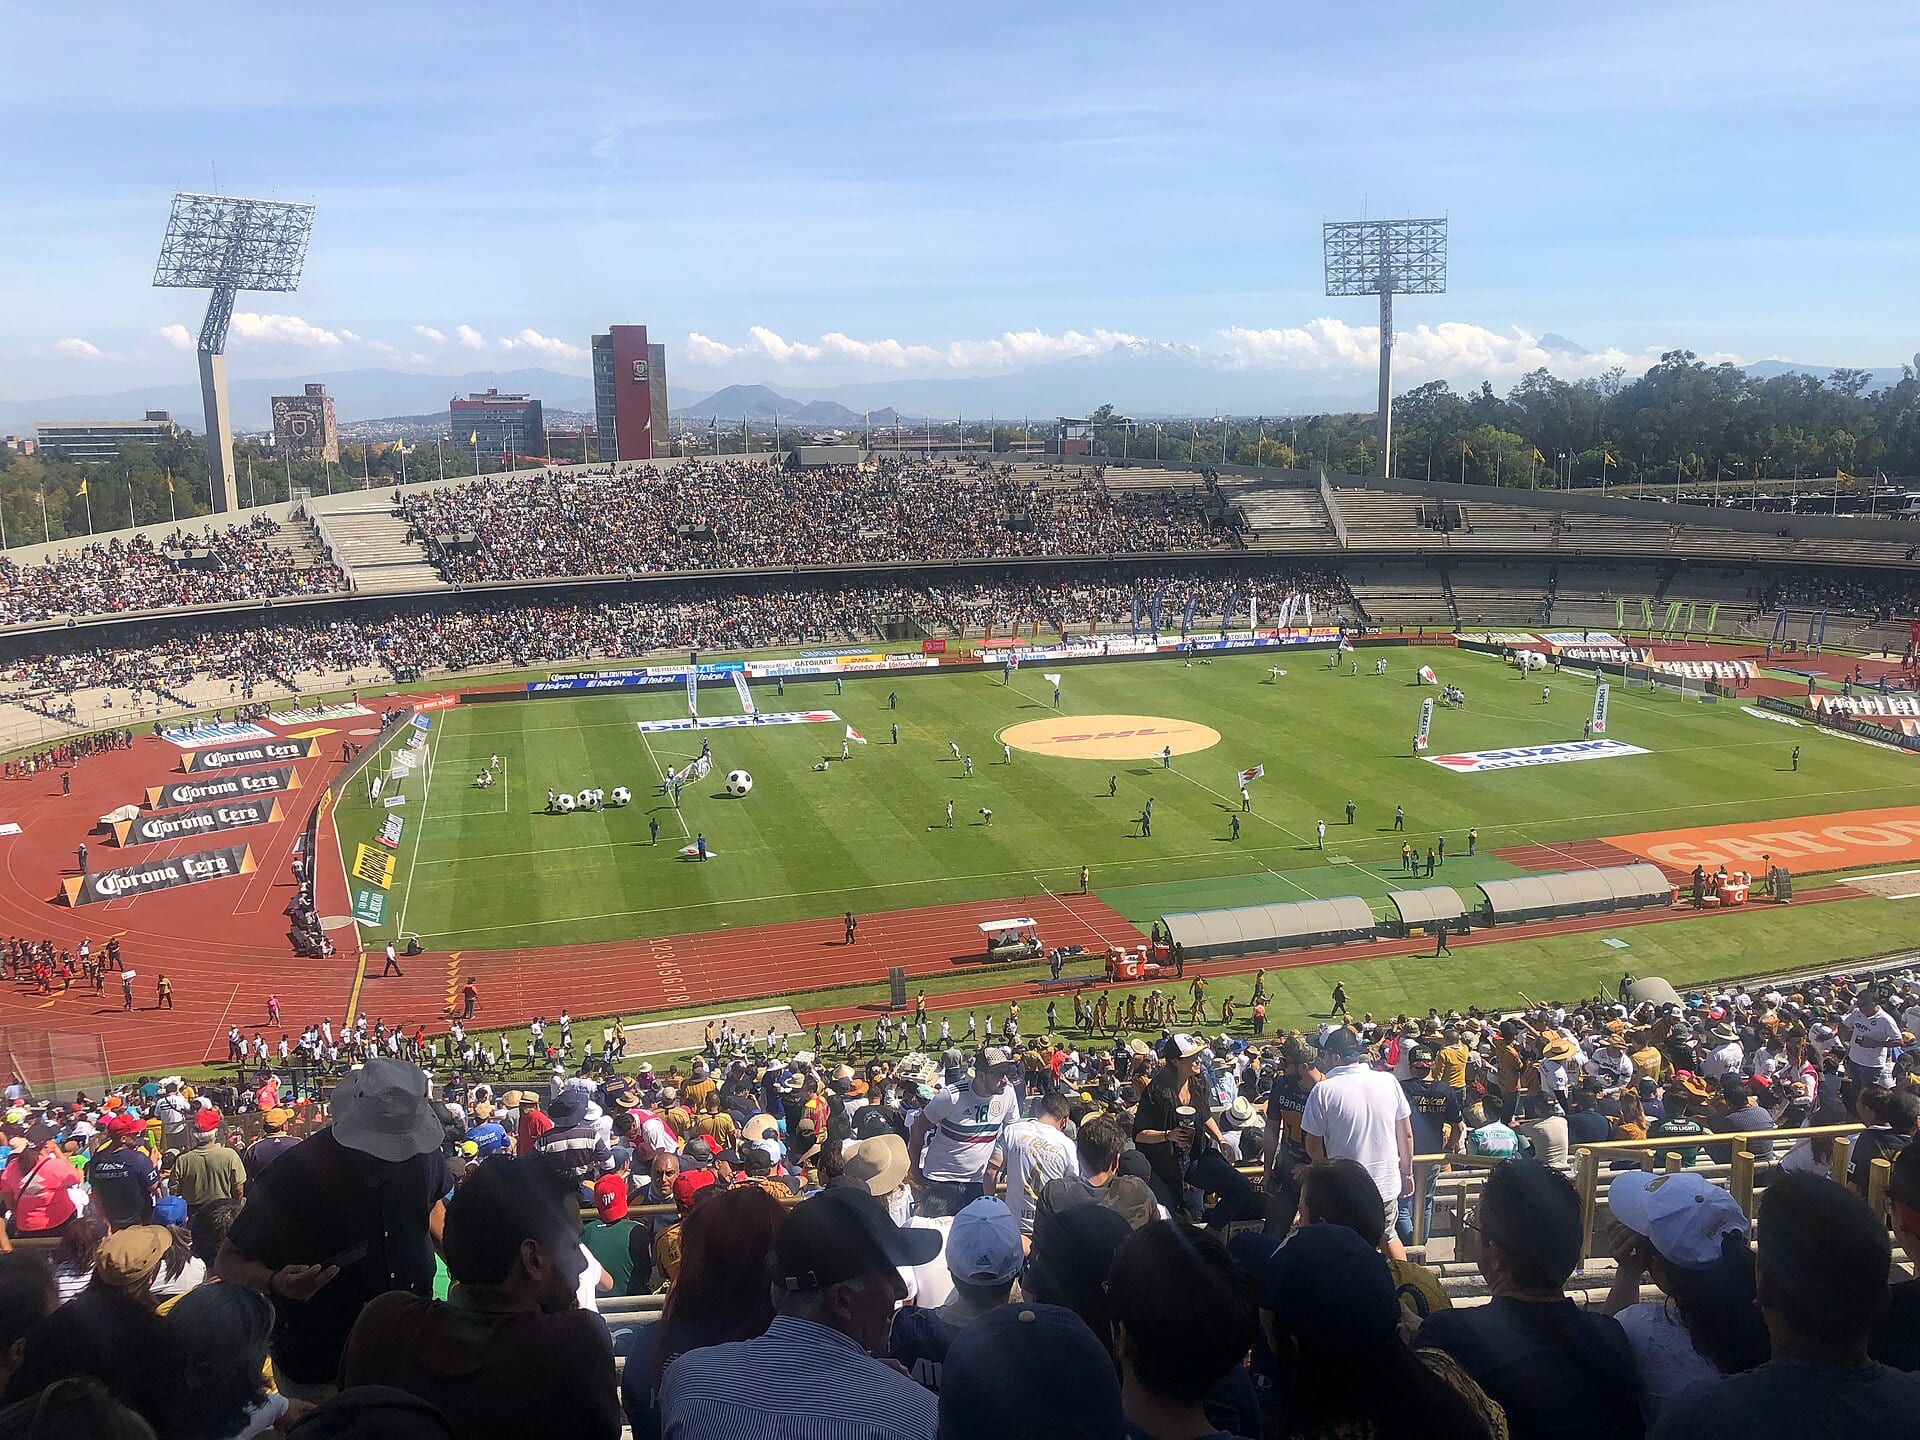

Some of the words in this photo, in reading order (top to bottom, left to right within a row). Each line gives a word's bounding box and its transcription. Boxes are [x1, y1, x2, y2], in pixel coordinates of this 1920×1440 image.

[794, 658, 834, 667] GATORADE
[550, 672, 578, 682] Corona
[595, 678, 626, 688] telcel
[647, 675, 677, 685] telcel
[698, 672, 726, 681] telcel
[543, 681, 574, 691] telcel
[1596, 687, 1606, 721] SUZUKI
[1420, 702, 1431, 736] SUZUKI
[1051, 728, 1169, 743] DHL
[1857, 721, 1904, 745] UNION
[203, 748, 264, 768] Corona
[265, 742, 300, 758] Cero
[1476, 739, 1629, 761] SUZUKI
[1477, 757, 1561, 770] AUTOS
[172, 782, 239, 803] Corona
[240, 774, 279, 790] Cero
[141, 813, 216, 839] Corona
[218, 806, 260, 824] Cero
[94, 864, 180, 896] Corona
[181, 856, 228, 877] Cero
[1734, 890, 1744, 901] G
[1126, 963, 1137, 976] G
[1028, 1137, 1063, 1154] telcel
